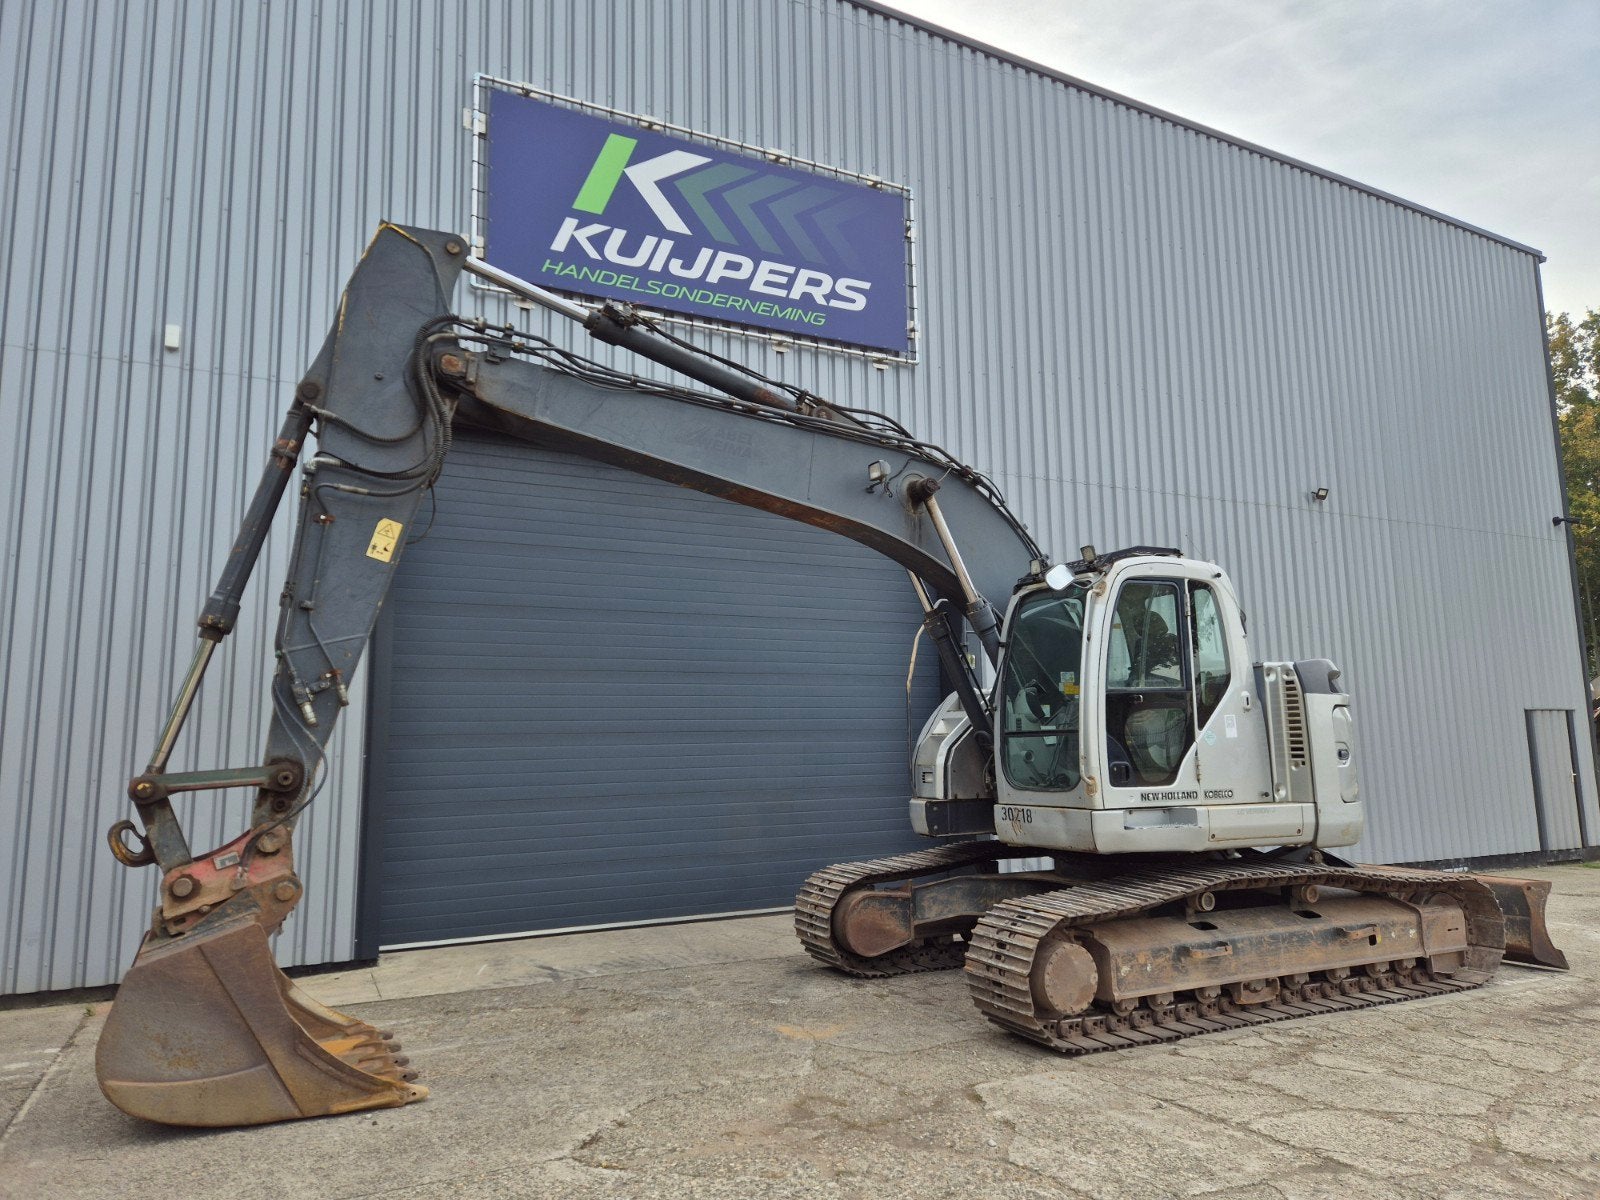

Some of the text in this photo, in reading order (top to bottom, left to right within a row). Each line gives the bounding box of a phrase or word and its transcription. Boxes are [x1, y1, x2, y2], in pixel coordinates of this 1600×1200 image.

[550, 217, 872, 311] KUIJPERS
[541, 258, 827, 327] HANDELSONDERNEMING
[1001, 806, 1033, 823] 30218
[1141, 789, 1234, 802] NEW HOLLAND KOBELCO
